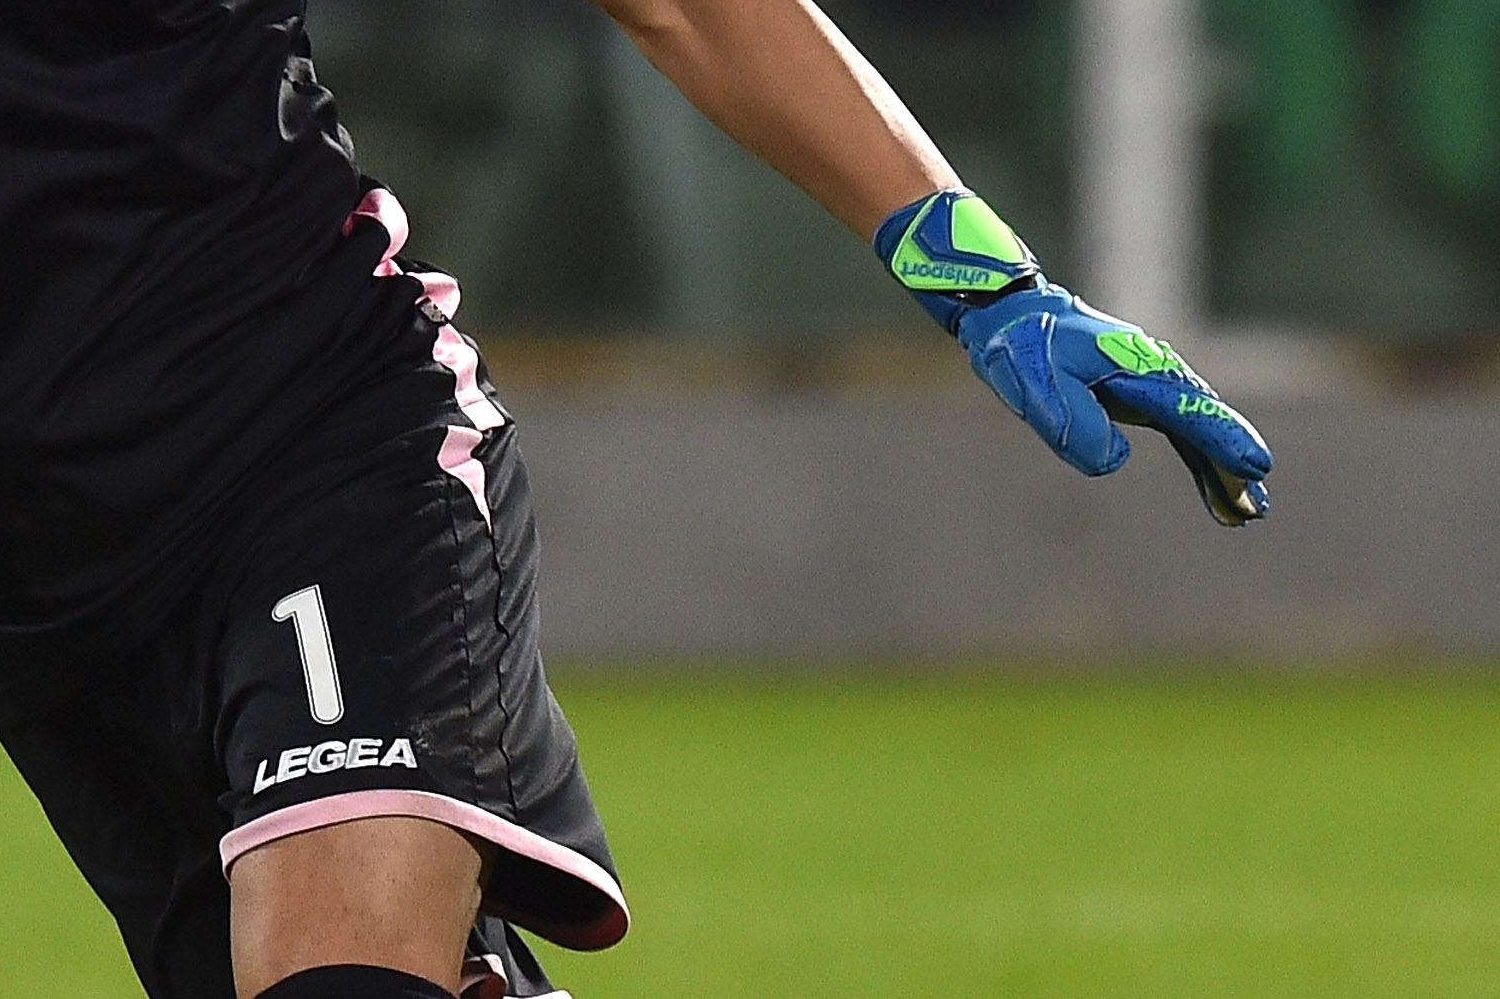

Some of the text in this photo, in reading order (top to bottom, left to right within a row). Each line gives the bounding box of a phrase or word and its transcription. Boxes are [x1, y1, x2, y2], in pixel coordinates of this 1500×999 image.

[902, 260, 990, 286] uhlsport
[271, 584, 344, 725] 1
[253, 738, 417, 795] LEGEA
